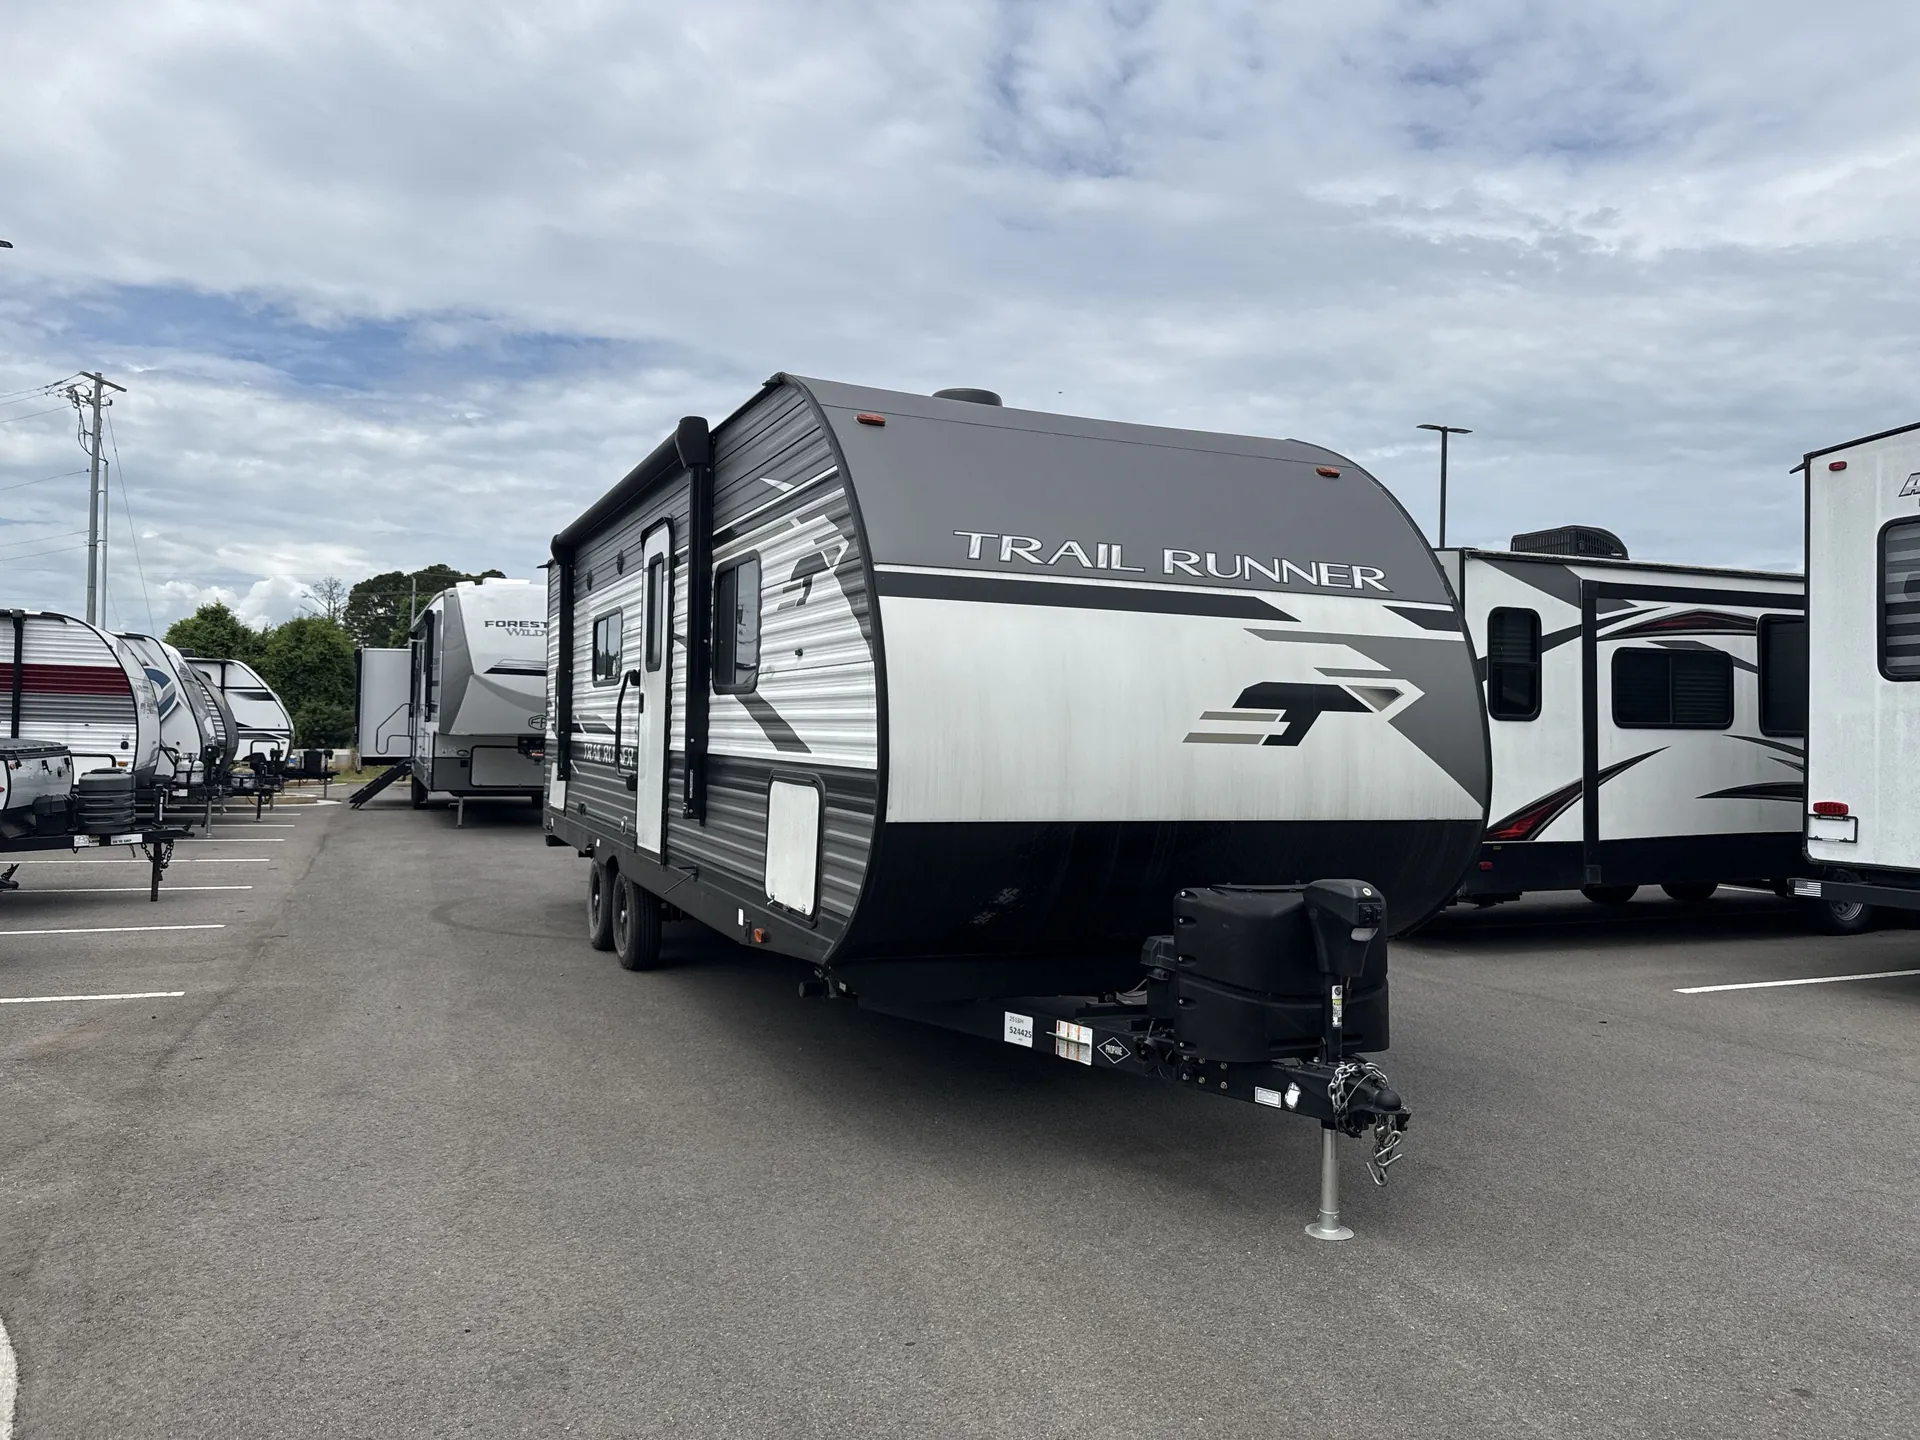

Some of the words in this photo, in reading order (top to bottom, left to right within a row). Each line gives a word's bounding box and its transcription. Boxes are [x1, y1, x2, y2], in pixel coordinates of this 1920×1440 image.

[953, 530, 1145, 573] TRAIL
[1162, 547, 1394, 593] RUNNER
[484, 620, 548, 628] FOREST
[583, 743, 601, 761] TRAIL
[1009, 1026, 1032, 1038] 524425
[1105, 1044, 1123, 1056] PROPANE
